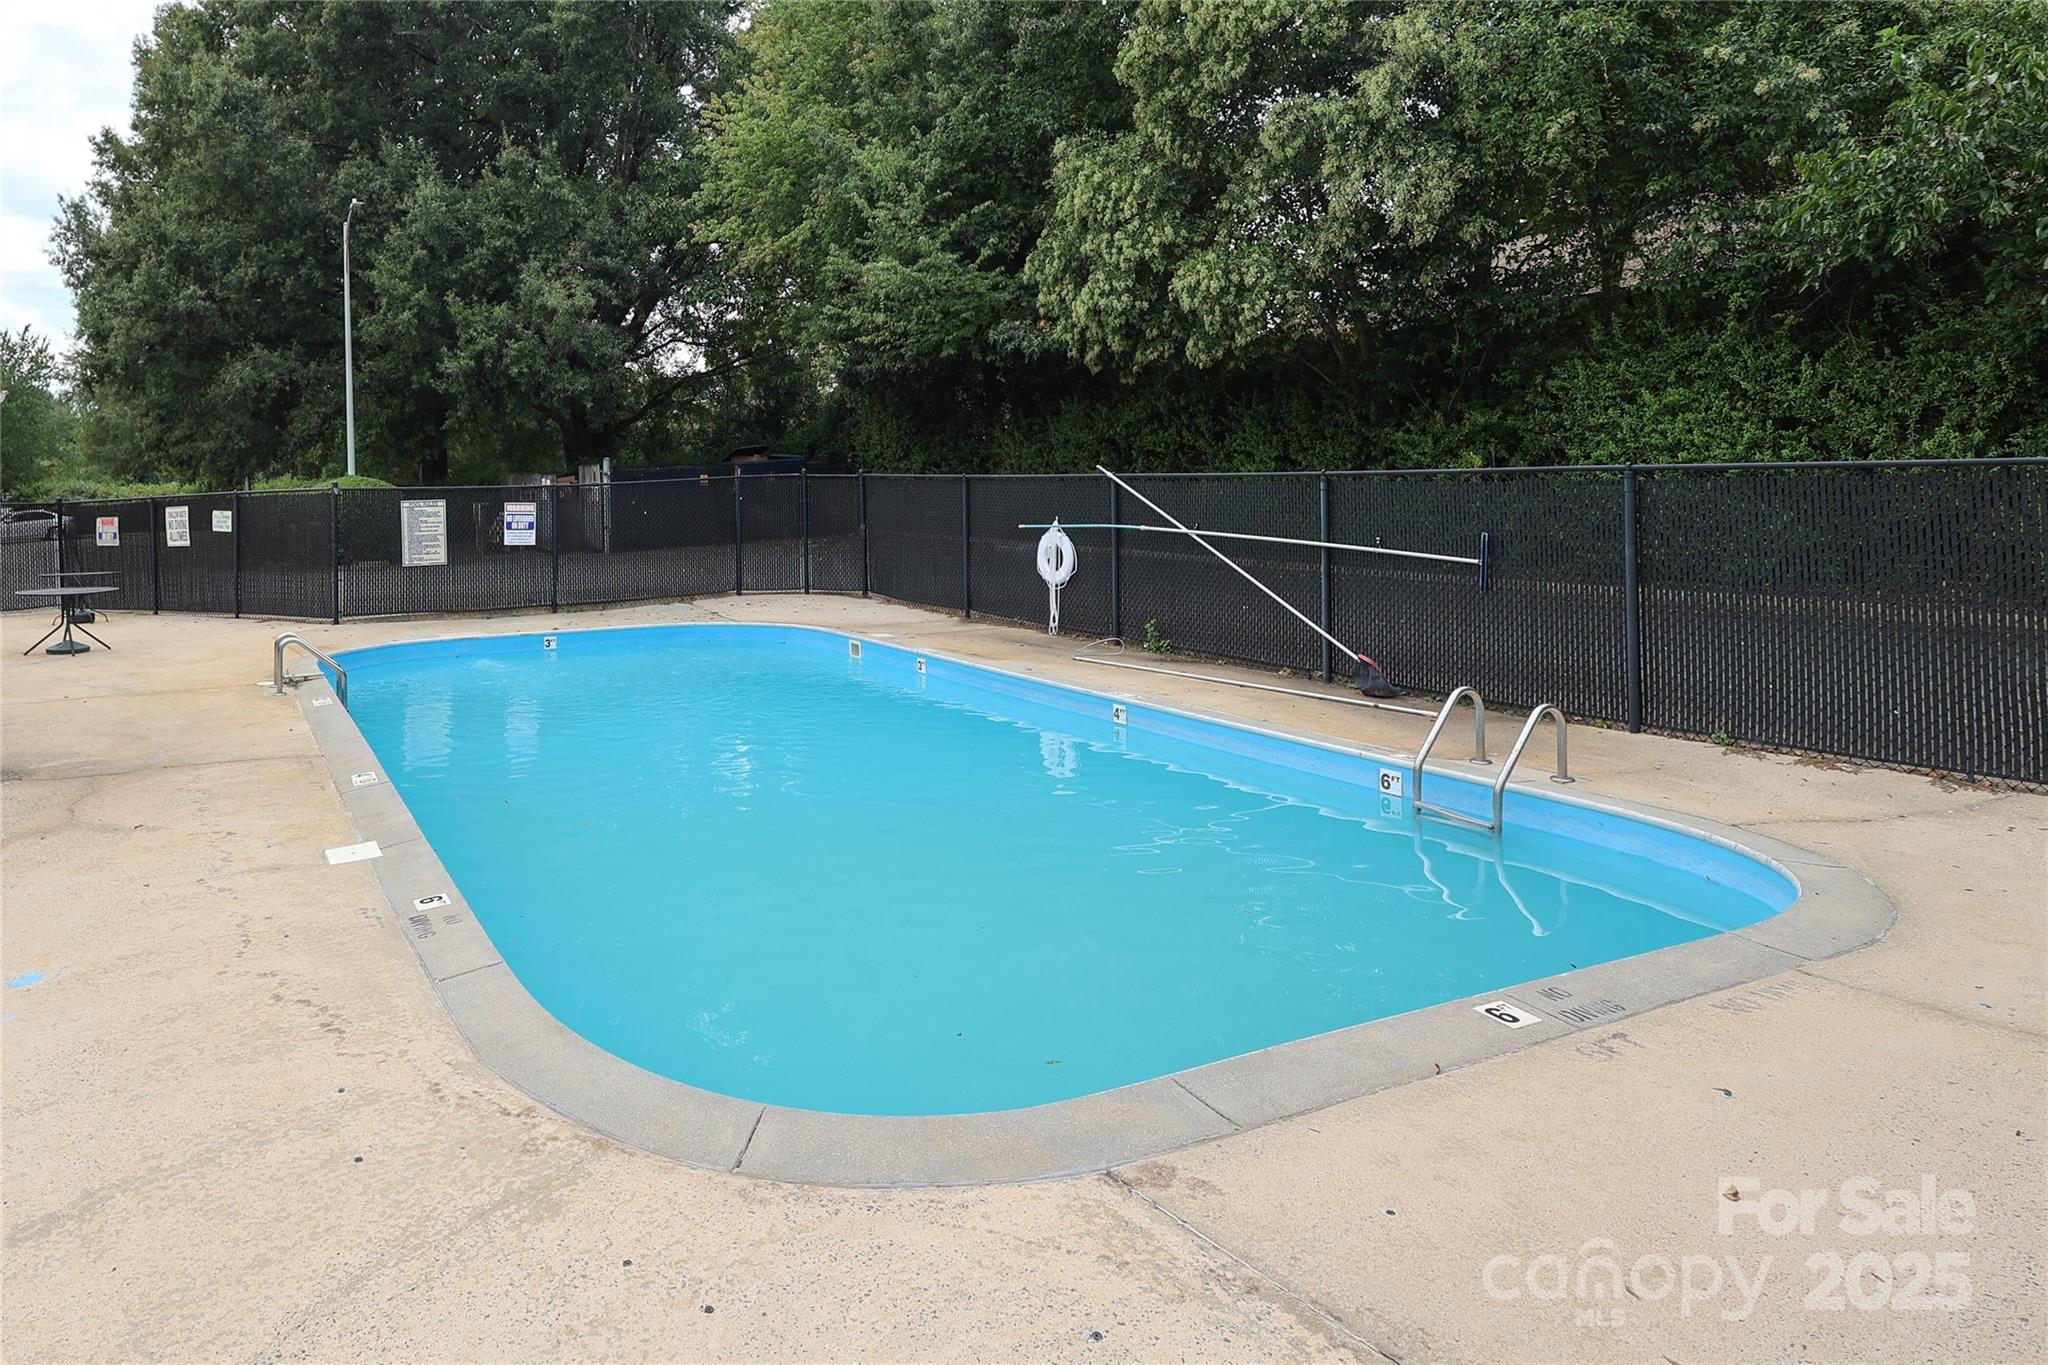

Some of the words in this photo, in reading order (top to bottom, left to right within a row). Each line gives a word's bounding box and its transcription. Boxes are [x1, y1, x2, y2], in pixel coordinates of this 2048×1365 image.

[506, 504, 535, 512] WARNING
[1536, 986, 1573, 1002] NO
[1557, 999, 1626, 1025] DIVING
